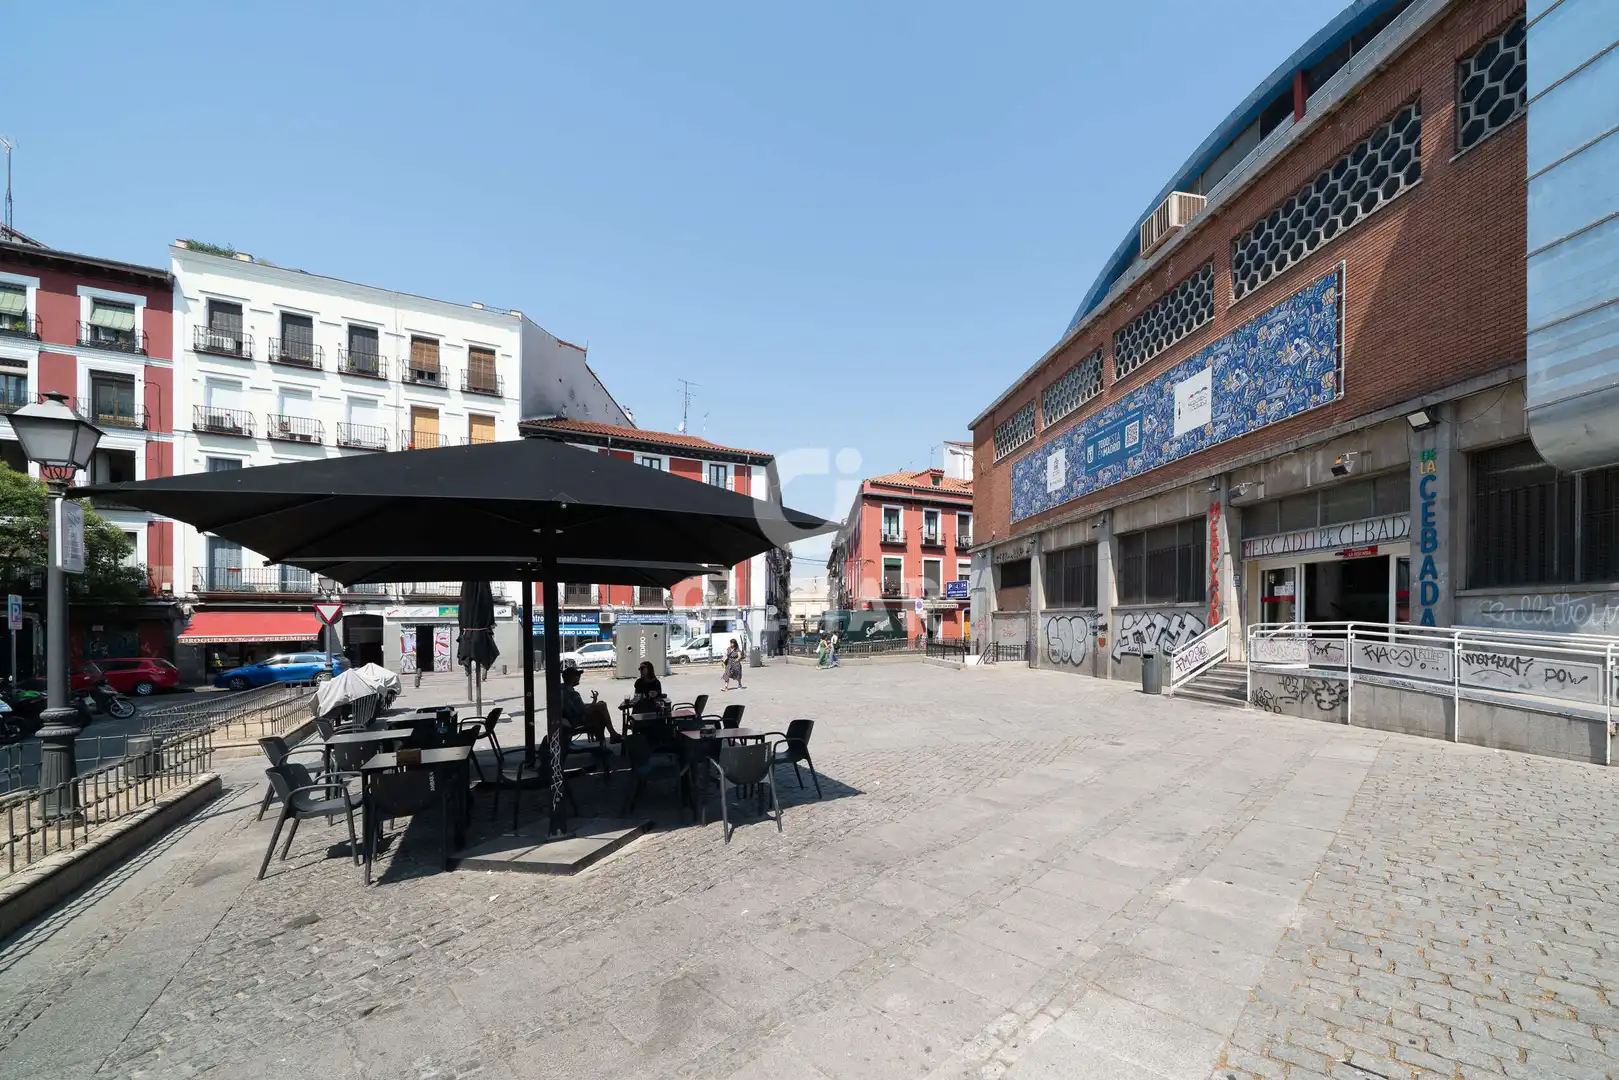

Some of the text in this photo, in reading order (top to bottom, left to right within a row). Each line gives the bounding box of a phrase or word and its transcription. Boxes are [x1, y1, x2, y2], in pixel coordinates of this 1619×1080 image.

[1420, 447, 1438, 462] DE
[1420, 460, 1437, 475] LA
[1242, 531, 1315, 558] MERCADO
[1418, 474, 1440, 633] CEBADA
[1209, 501, 1221, 626] MERCADO
[12, 604, 20, 621] P
